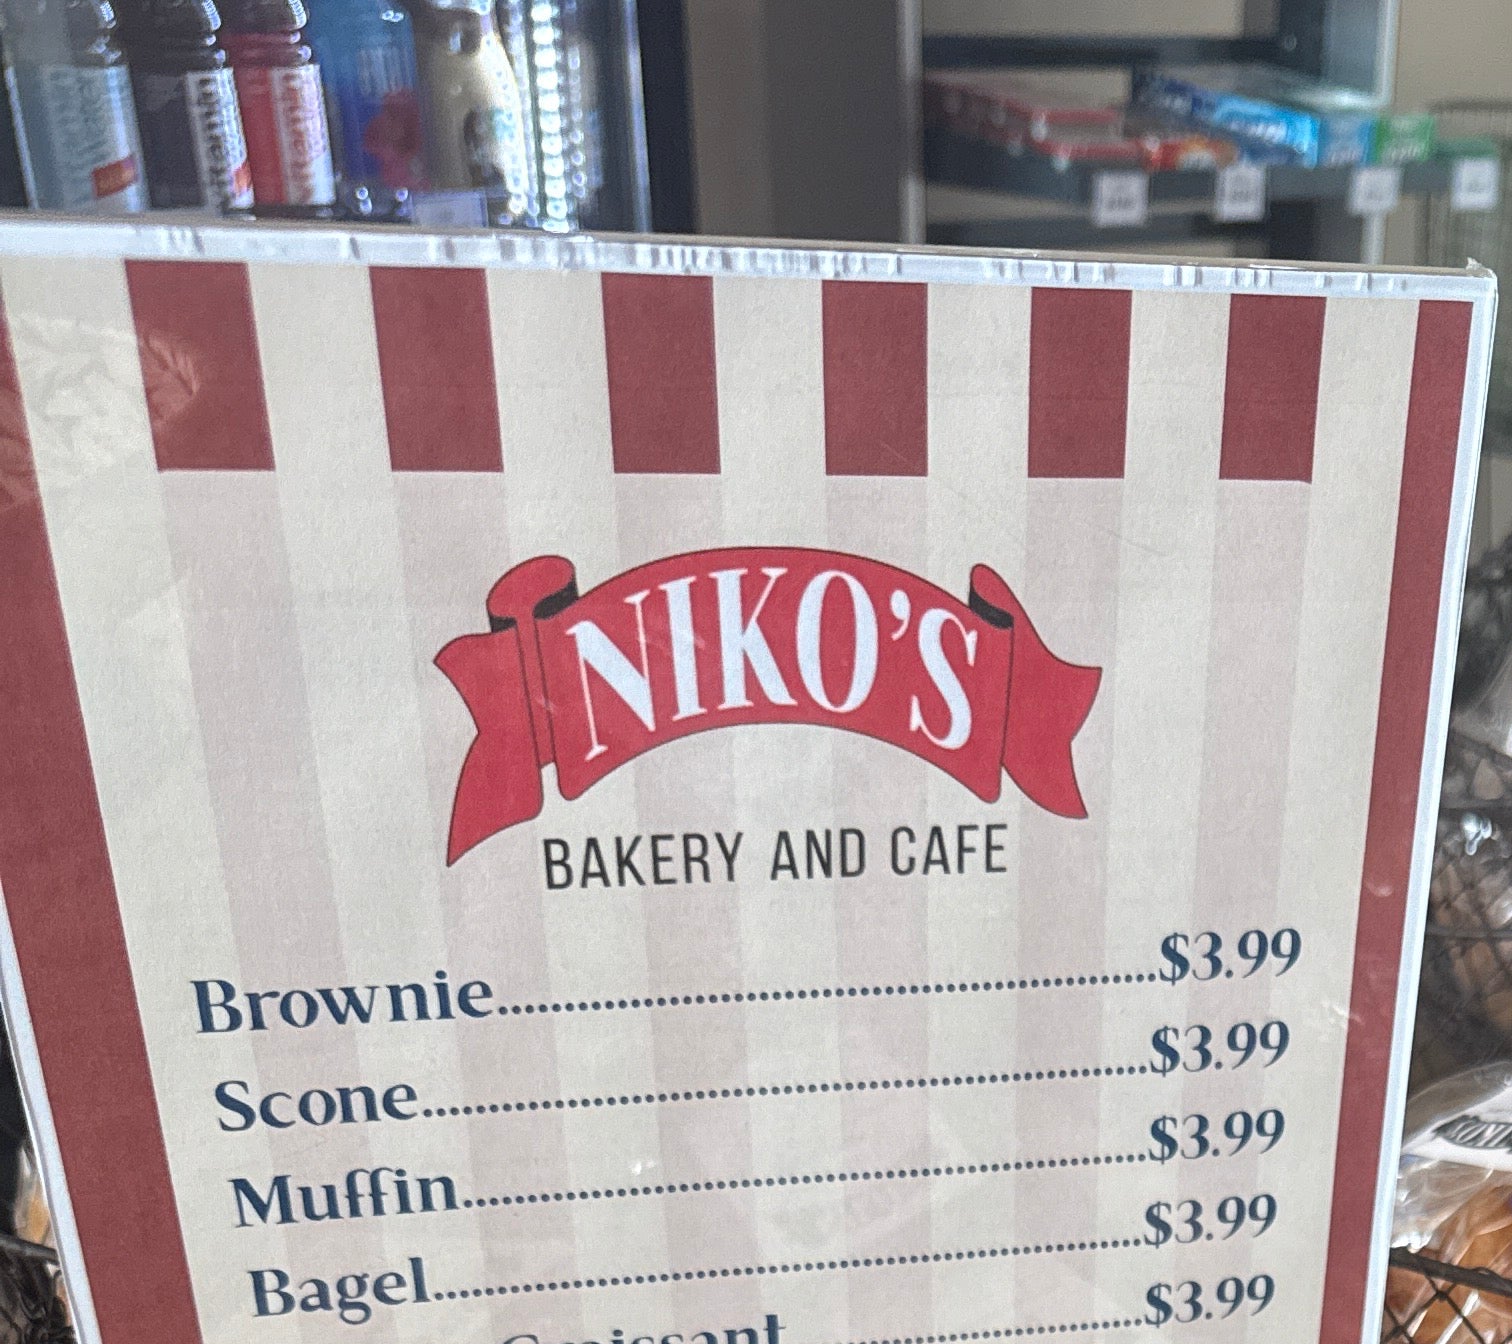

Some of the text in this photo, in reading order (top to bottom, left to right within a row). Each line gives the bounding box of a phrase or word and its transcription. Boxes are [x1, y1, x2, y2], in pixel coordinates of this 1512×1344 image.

[566, 567, 979, 761] NIKO'S
[542, 824, 1007, 889] BAKERY AND CAFE
[190, 928, 1302, 1034] Brownie $3.99
[214, 1020, 1290, 1131] Scone $3.99
[228, 1108, 1285, 1228] Muffin $3.99
[247, 1194, 1278, 1326] Bagel $3.99
[1144, 1274, 1275, 1327] $3.99
